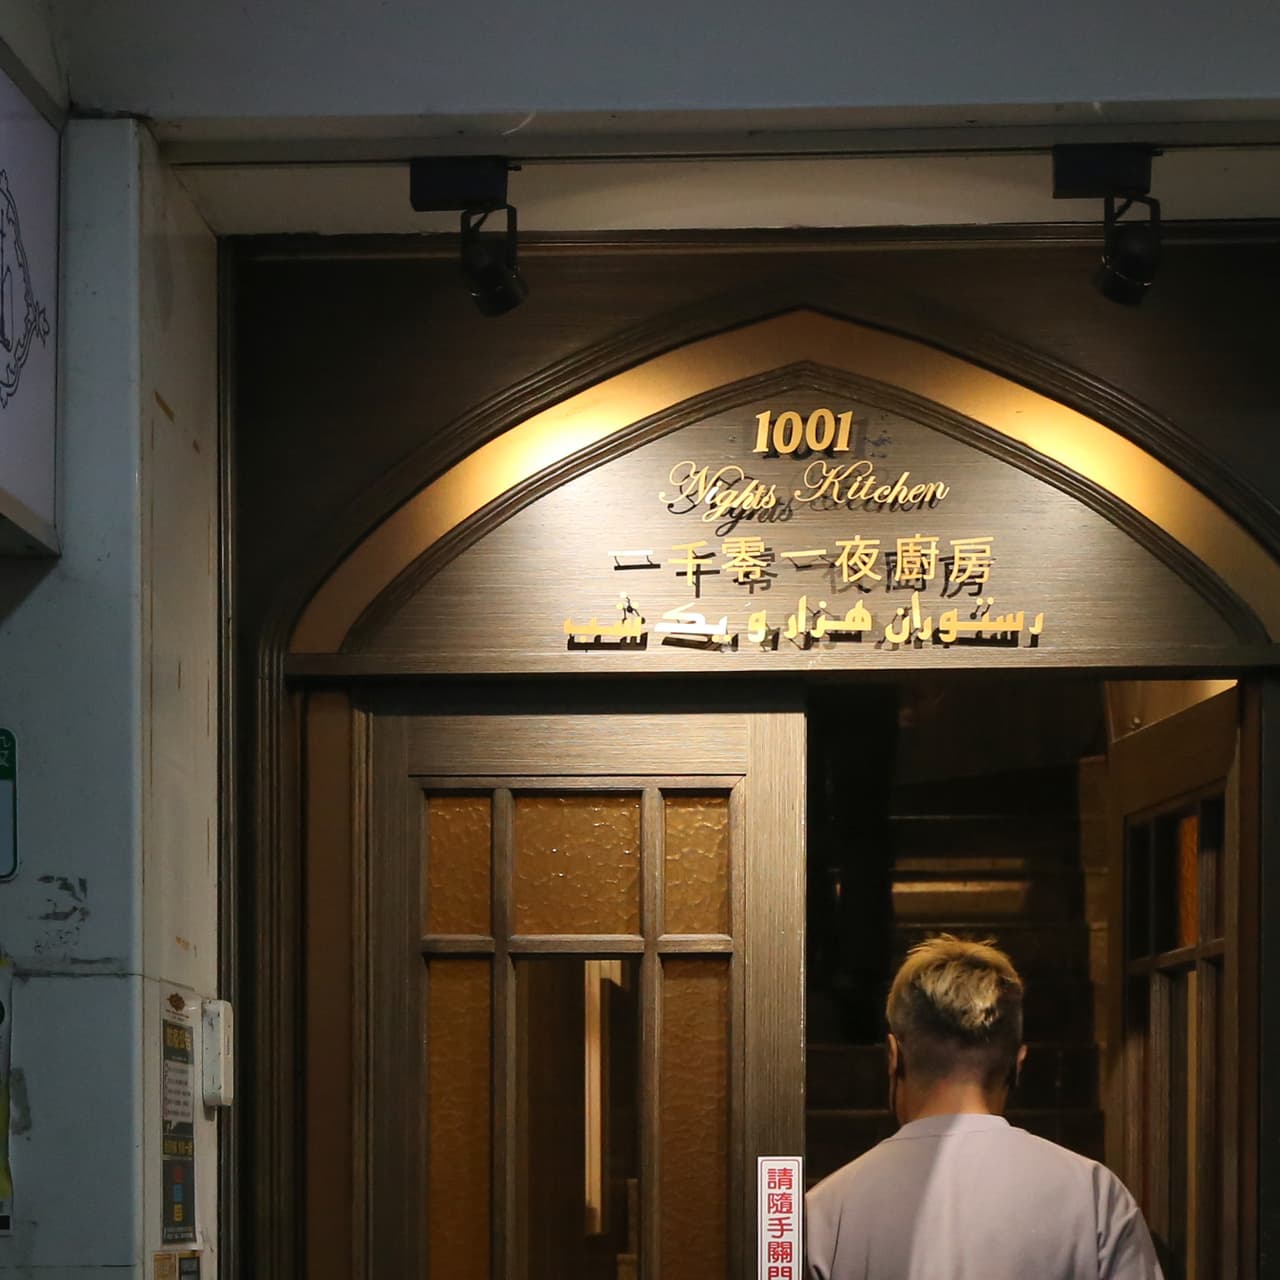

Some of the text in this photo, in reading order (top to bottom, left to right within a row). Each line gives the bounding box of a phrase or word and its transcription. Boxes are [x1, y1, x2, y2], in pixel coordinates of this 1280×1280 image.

[753, 408, 854, 454] 1001
[659, 459, 950, 522] Nights Kitchen
[607, 533, 996, 584] 一千零一夜廚房
[747, 609, 767, 643] و
